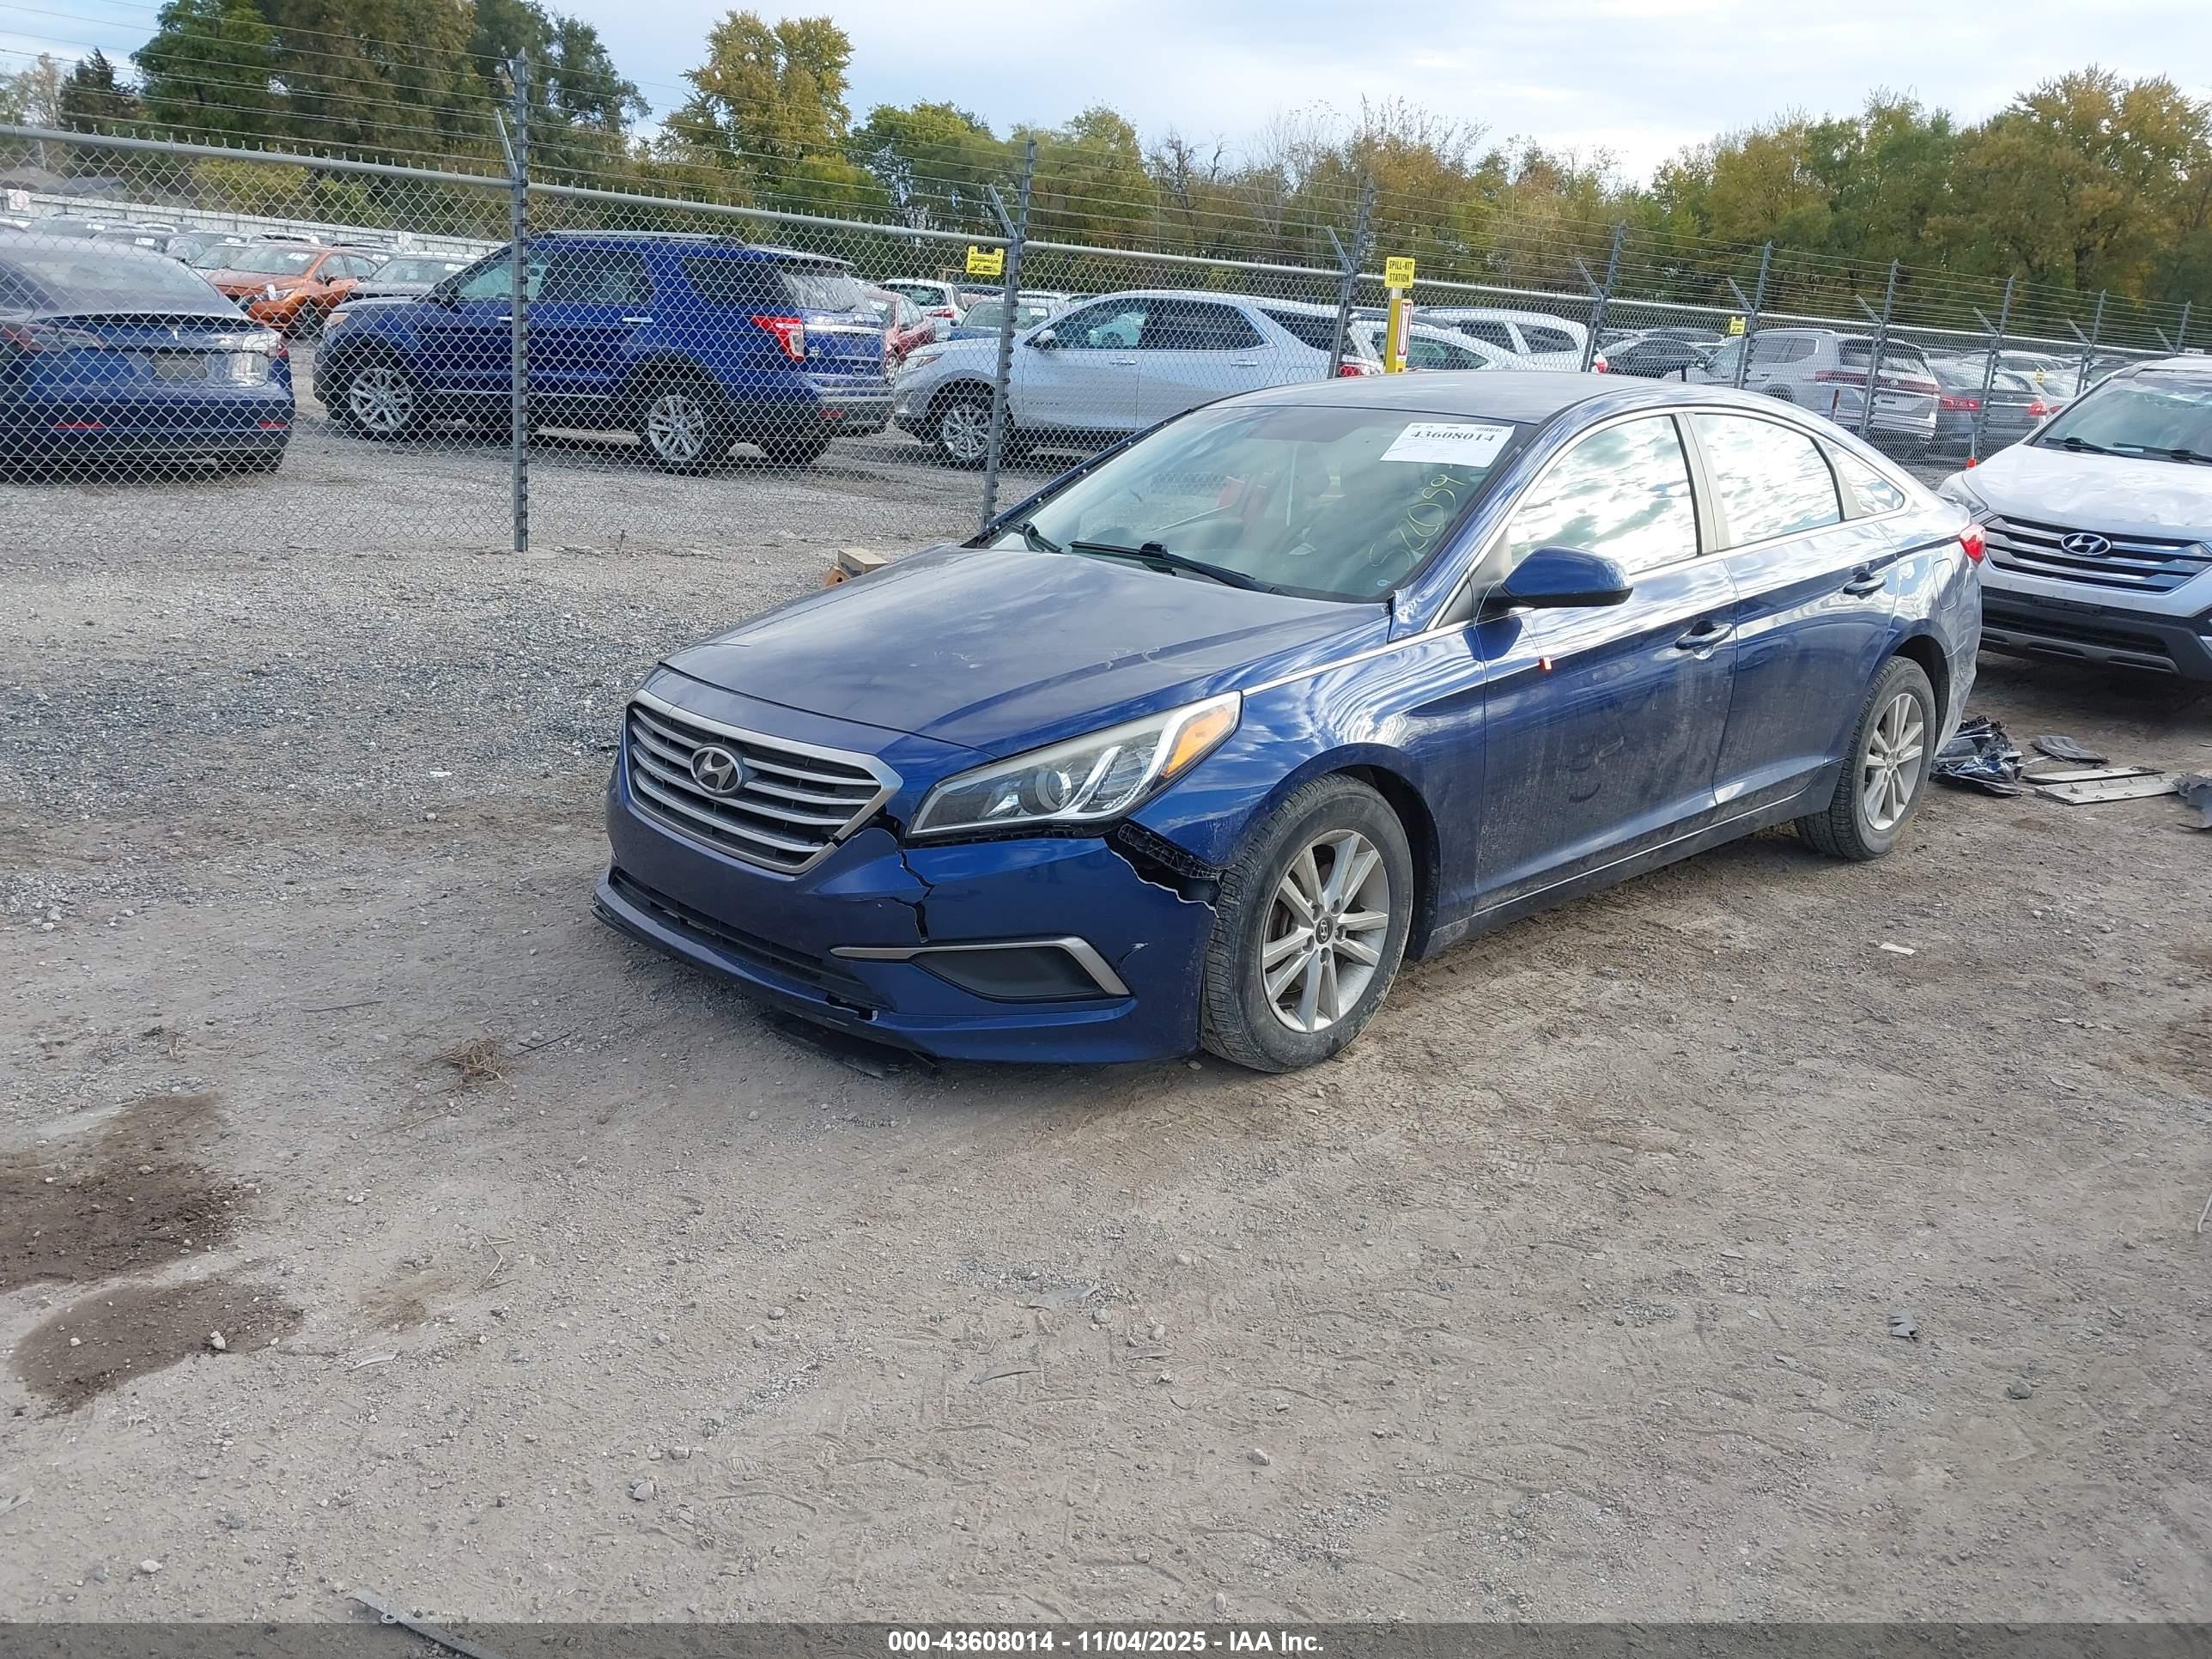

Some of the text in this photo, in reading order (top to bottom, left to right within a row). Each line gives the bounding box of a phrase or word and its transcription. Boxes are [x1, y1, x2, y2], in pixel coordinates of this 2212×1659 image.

[1389, 260, 1413, 270] SPILL-KIT
[1389, 273, 1410, 283] STATION
[1411, 430, 1496, 442] 43608014
